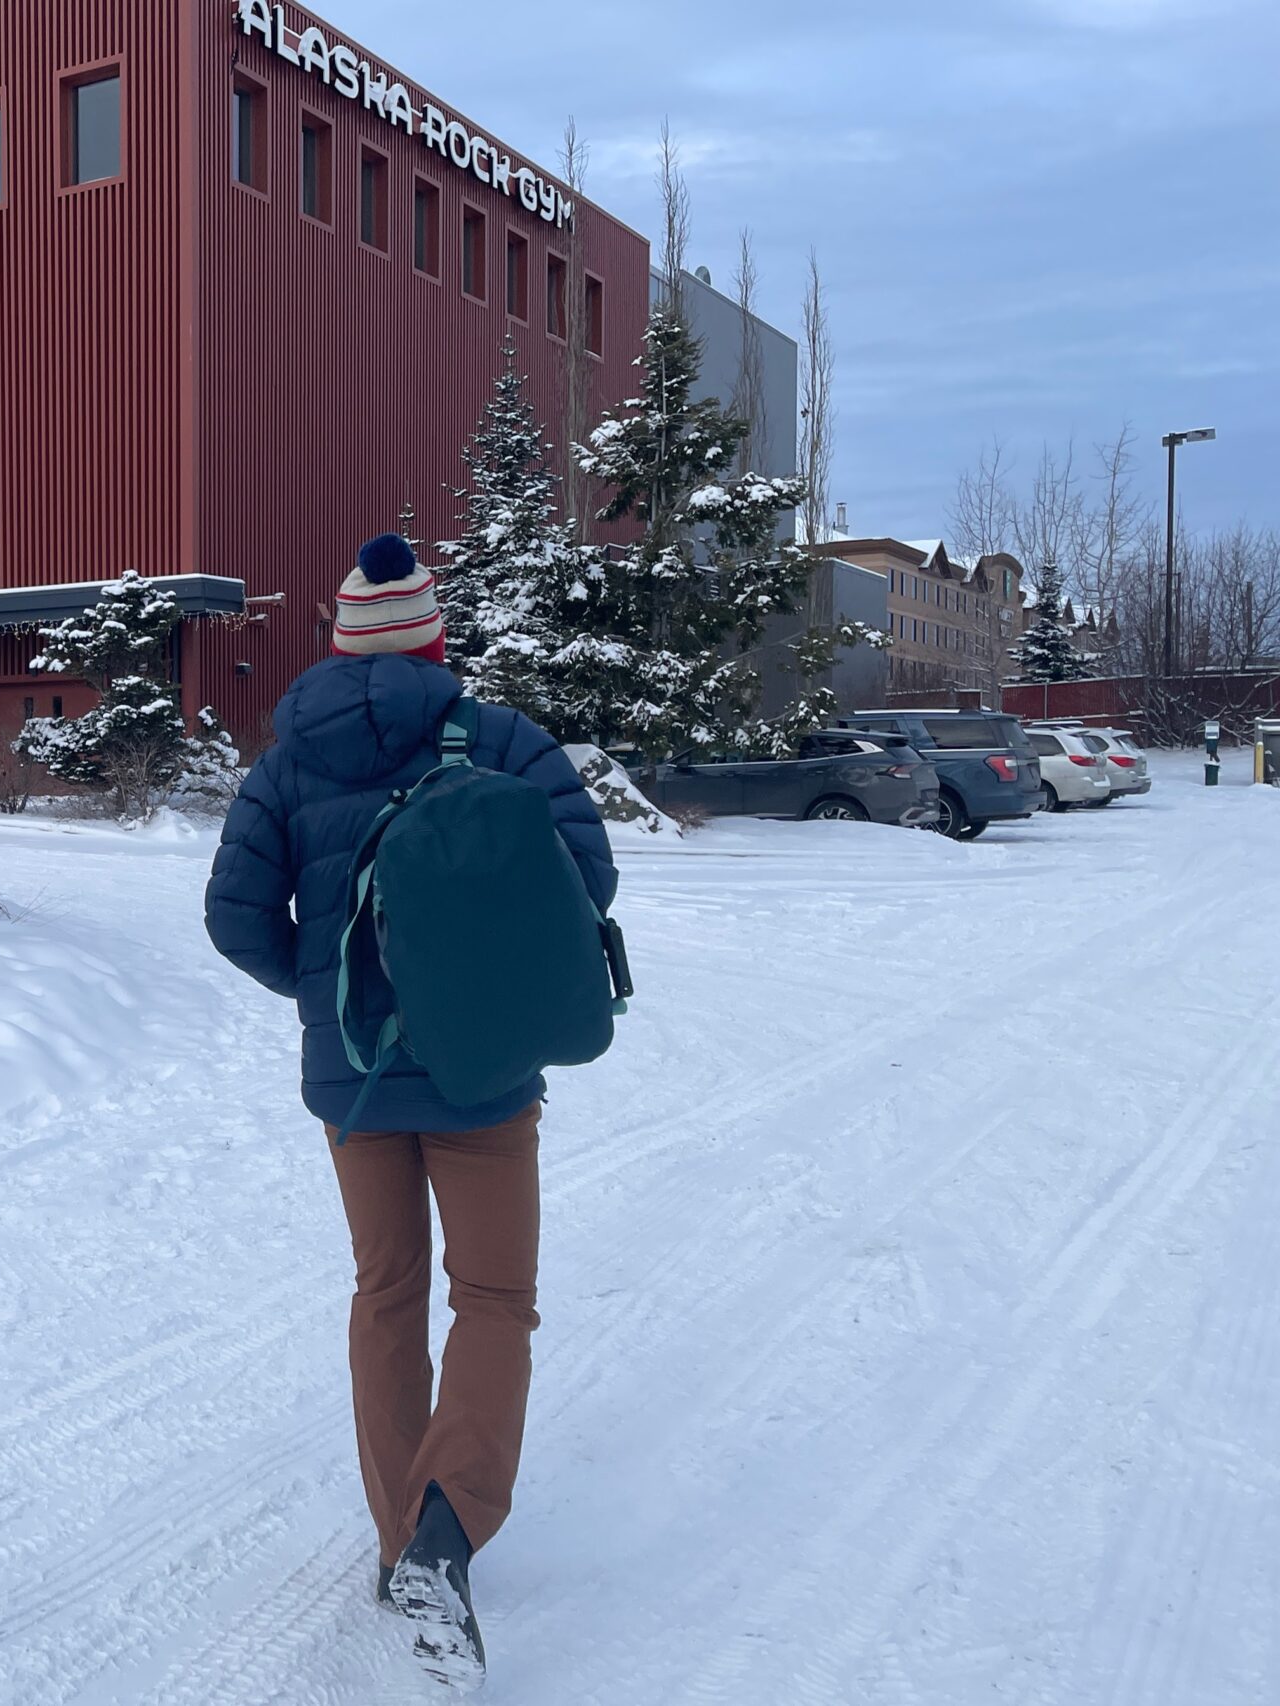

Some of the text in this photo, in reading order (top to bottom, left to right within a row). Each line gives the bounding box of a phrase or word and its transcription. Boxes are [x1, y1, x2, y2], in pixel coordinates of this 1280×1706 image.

[234, 0, 576, 236] ALASKA ROCK GYM
